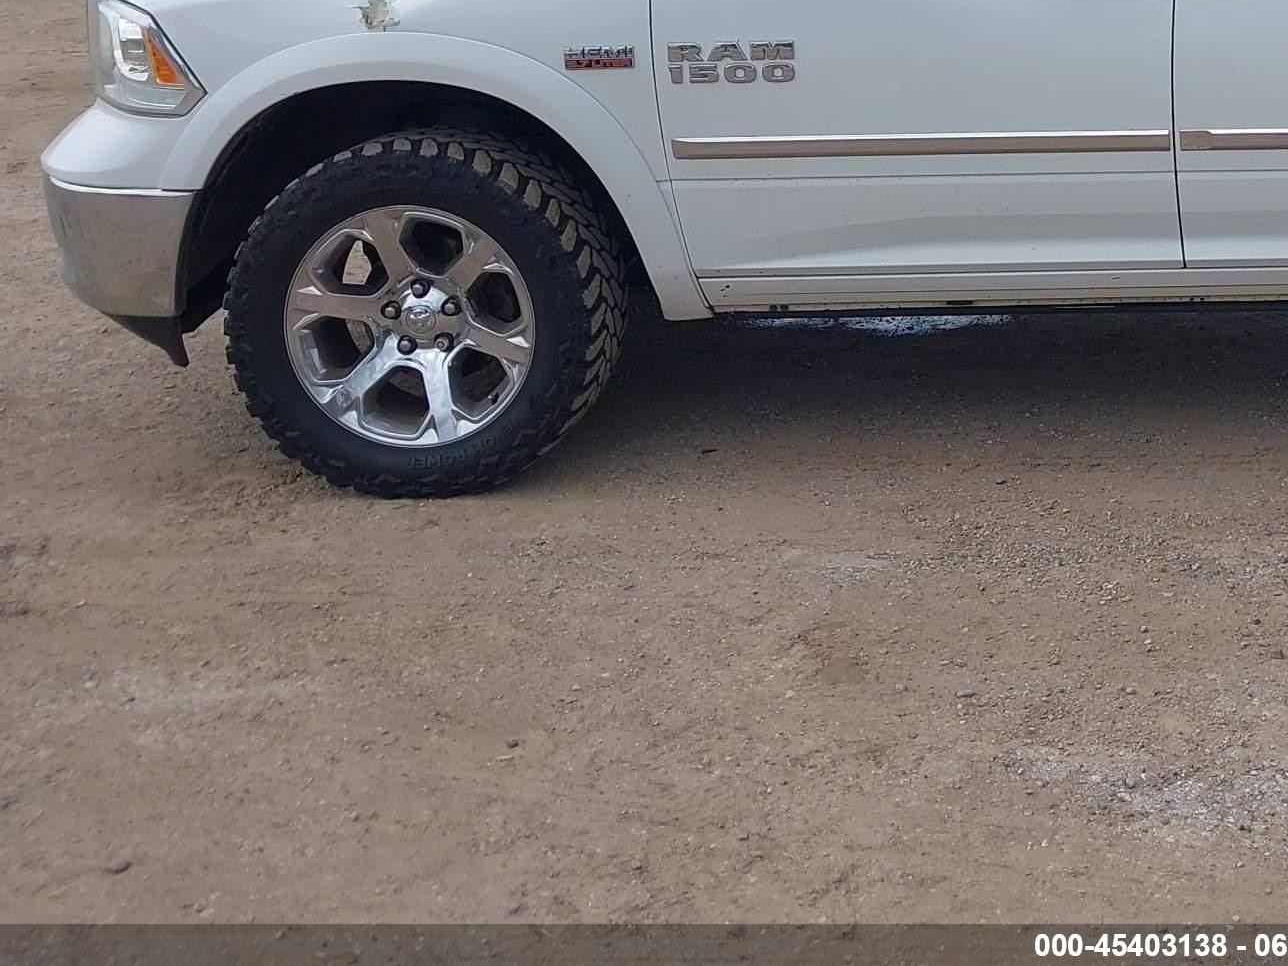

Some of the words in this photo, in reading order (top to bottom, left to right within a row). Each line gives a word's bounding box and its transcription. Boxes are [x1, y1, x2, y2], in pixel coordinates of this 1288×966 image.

[563, 45, 635, 58] HEMI
[667, 41, 794, 62] RAM
[667, 63, 795, 84] 1500
